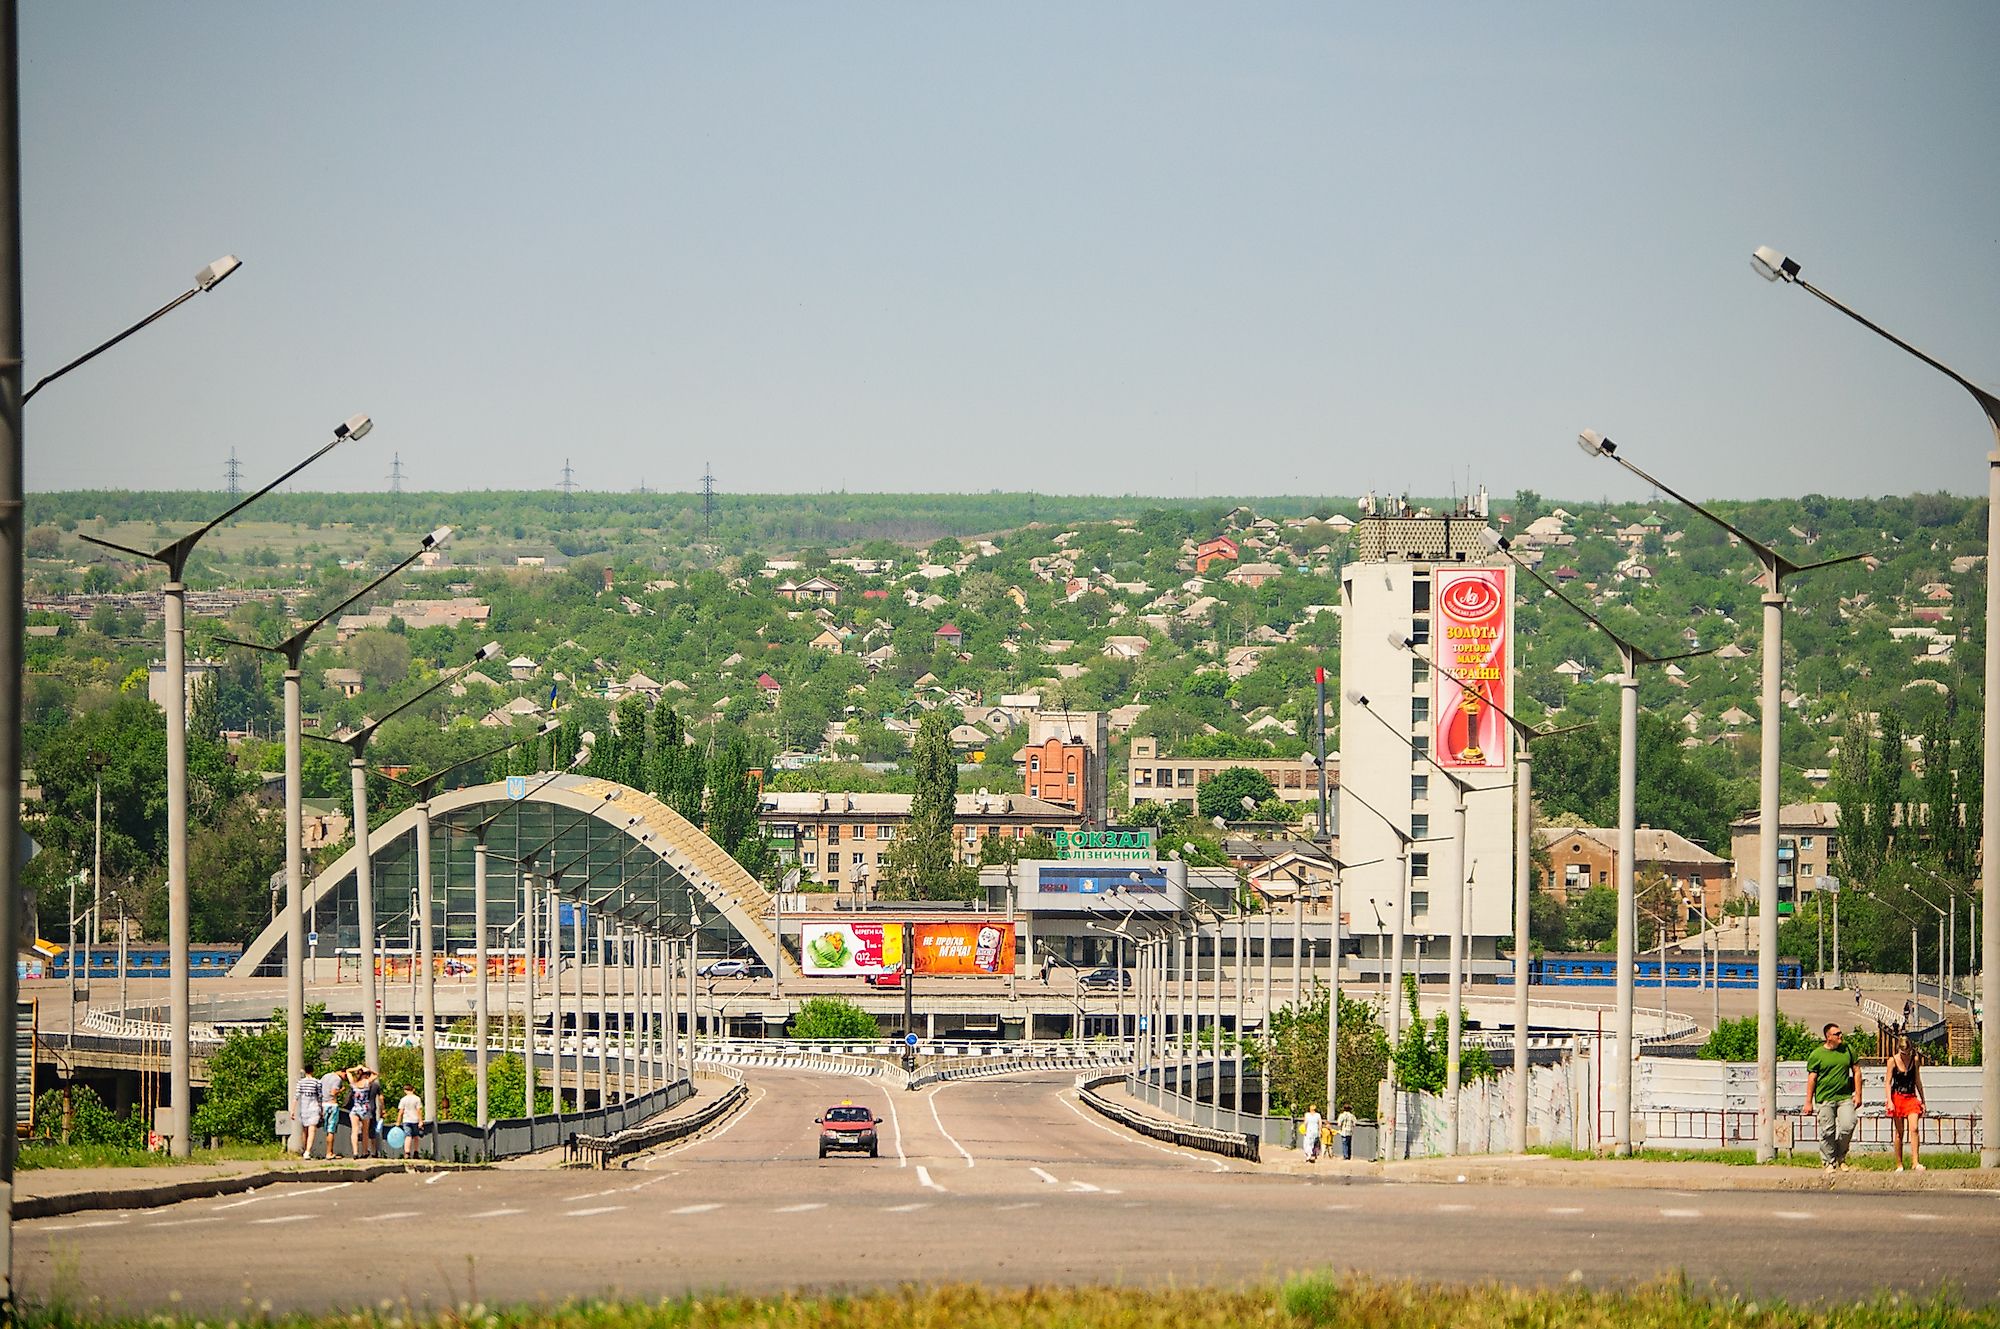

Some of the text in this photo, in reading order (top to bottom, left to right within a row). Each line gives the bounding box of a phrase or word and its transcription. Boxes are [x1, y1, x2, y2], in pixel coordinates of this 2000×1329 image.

[1447, 626, 1498, 639] ЗОЛОТА
[1453, 643, 1492, 653] ТОРГОВА
[1457, 654, 1488, 664] МАРКА
[1443, 666, 1500, 681] УКРАЇНИ
[1055, 831, 1151, 848] ВОКЗАЛ
[1057, 850, 1151, 860] ЗАЛІЗНИЧНИЙ
[923, 937, 934, 946] НЕ
